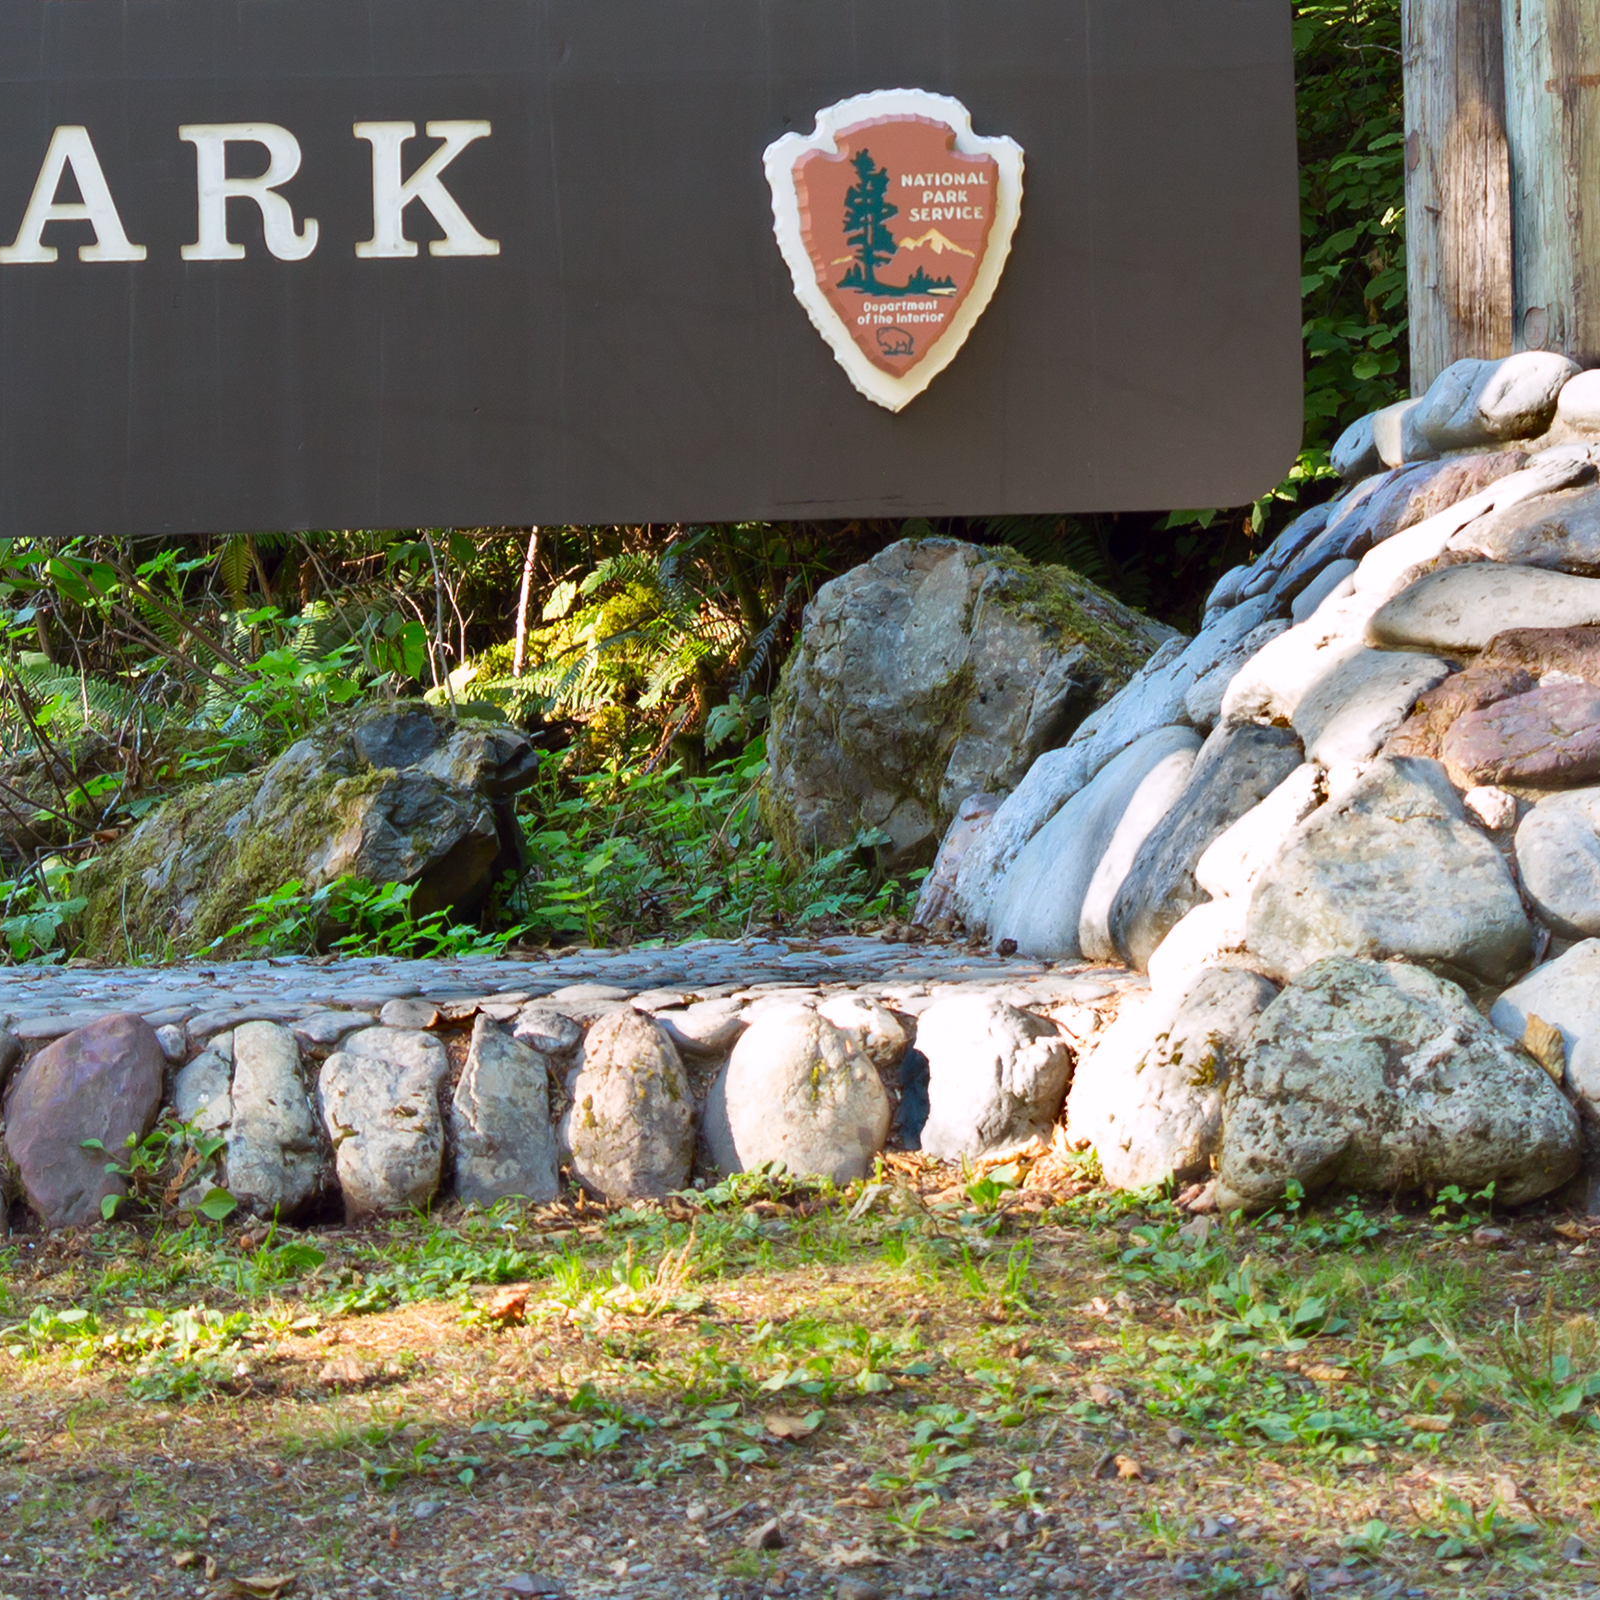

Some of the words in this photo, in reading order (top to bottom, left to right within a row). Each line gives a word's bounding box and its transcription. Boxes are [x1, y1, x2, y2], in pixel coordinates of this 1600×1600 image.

[901, 171, 988, 187] NATIONAL
[922, 190, 968, 204] PARK
[909, 206, 983, 222] SERVICE
[863, 300, 937, 313] Department
[857, 313, 871, 325] of
[873, 314, 893, 324] the
[896, 312, 944, 323] Interior
